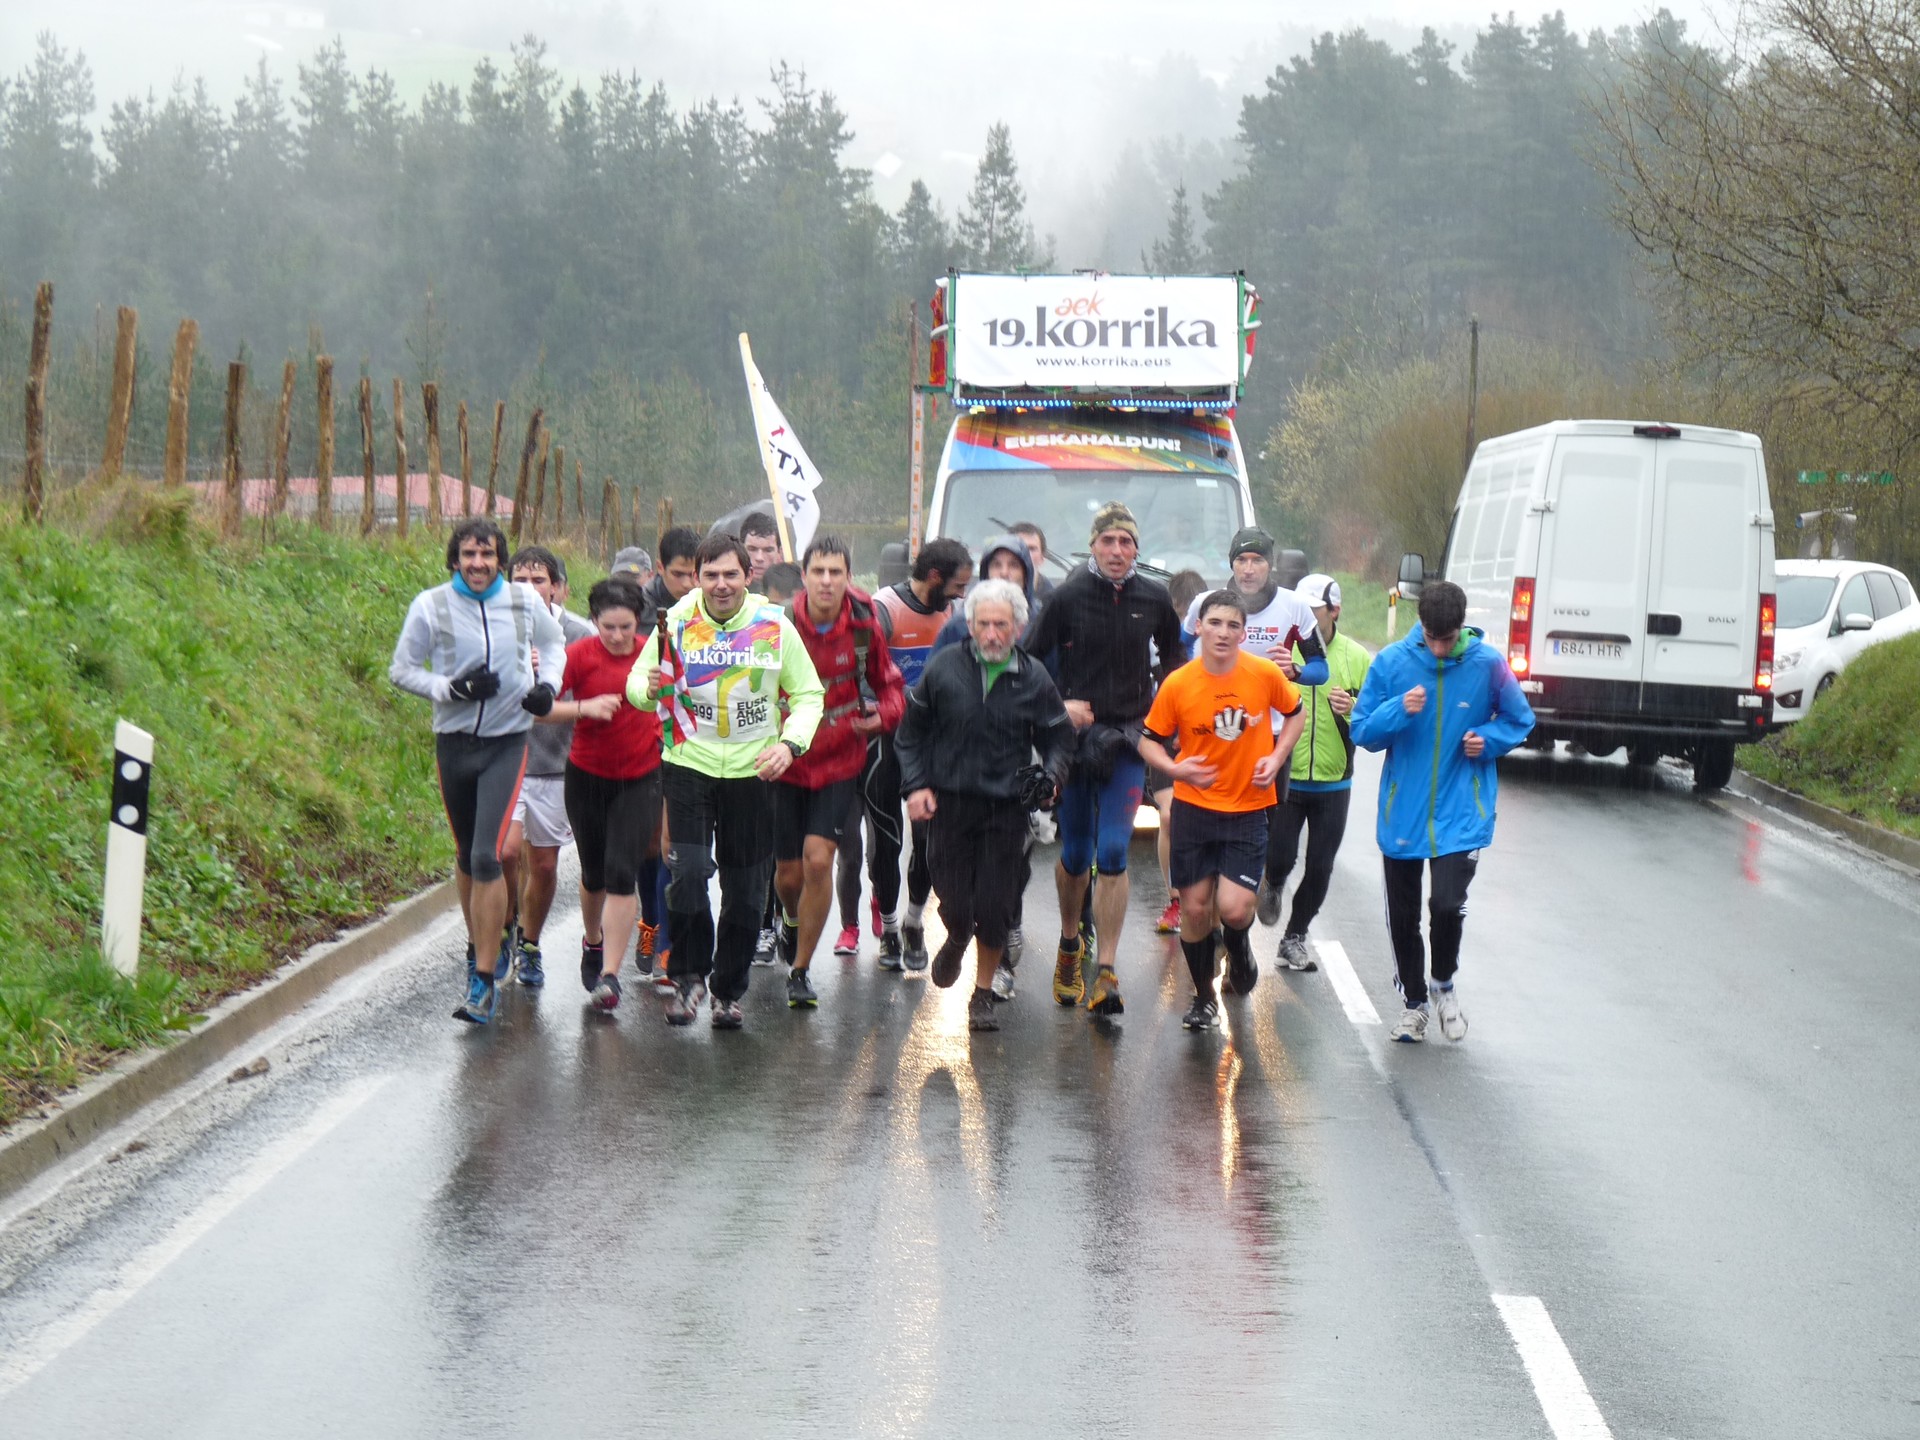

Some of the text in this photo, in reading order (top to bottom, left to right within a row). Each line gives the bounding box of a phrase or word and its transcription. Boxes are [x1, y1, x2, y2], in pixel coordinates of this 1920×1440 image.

[1055, 291, 1104, 316] aek
[983, 305, 1219, 349] 19.korrika
[1036, 355, 1172, 368] www.korrika.eus
[1004, 433, 1181, 452] EUSKAHALDUN!
[1553, 608, 1590, 617] IVECO
[1708, 616, 1737, 624] DAILY
[711, 638, 733, 651] aek
[1248, 633, 1278, 642] elay
[684, 644, 774, 666] 19.korrika
[1561, 641, 1622, 658] 6841 HTR
[736, 695, 769, 711] EUSK
[736, 704, 768, 720] AHAL
[737, 713, 768, 728] DUN!
